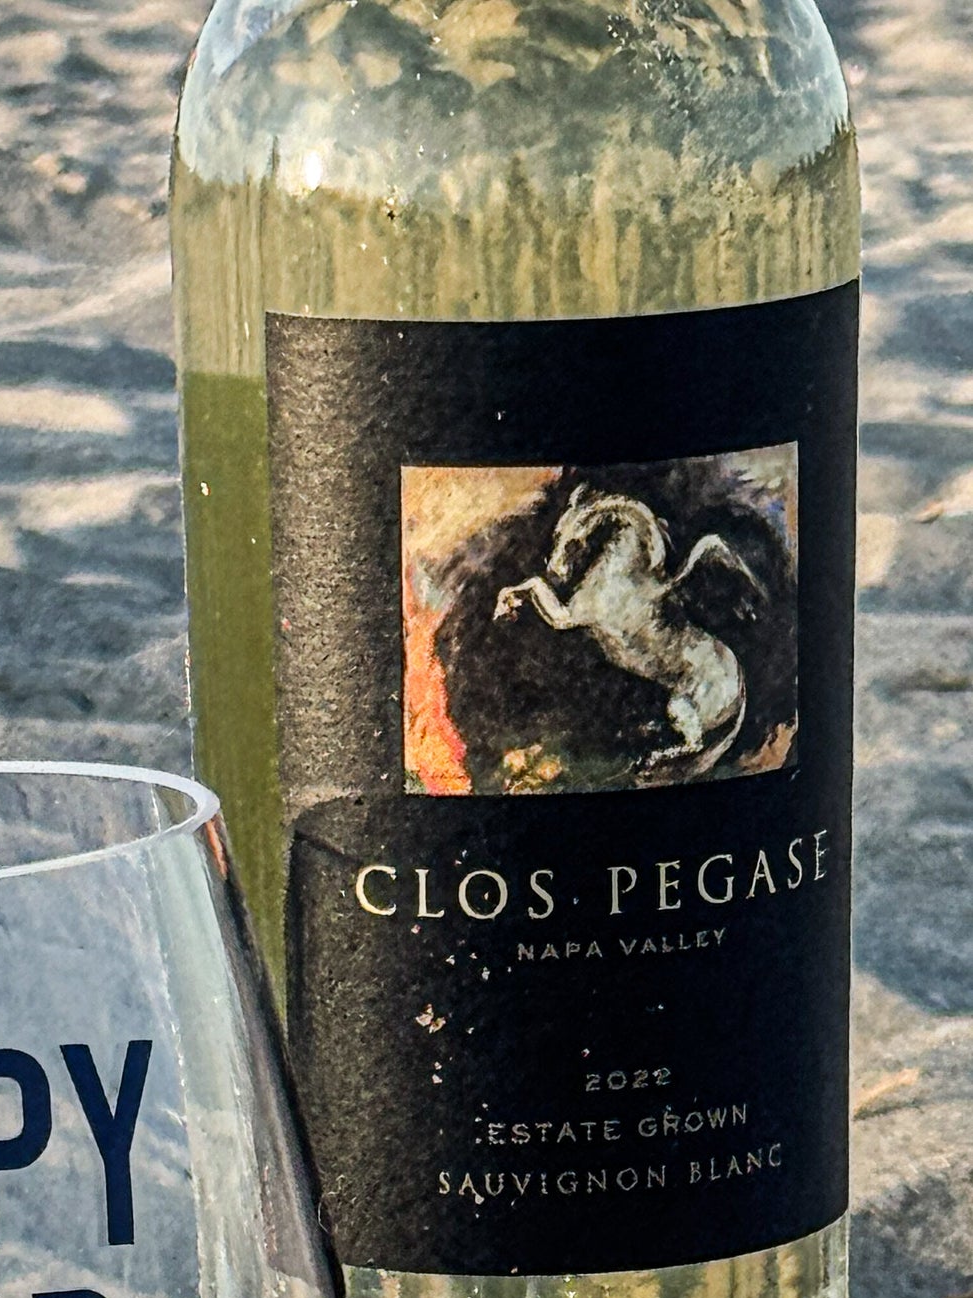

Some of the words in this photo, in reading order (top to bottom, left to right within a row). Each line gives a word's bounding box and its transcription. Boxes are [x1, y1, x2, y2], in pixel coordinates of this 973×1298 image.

[355, 865, 555, 920] CLOS
[607, 829, 829, 916] PEGASE
[517, 940, 603, 961] NAPA
[619, 927, 726, 956] VALLEY
[488, 1120, 620, 1145] ESTATE
[638, 1103, 747, 1137] GROWN
[438, 1165, 666, 1197] SAUVIGNON
[688, 1143, 782, 1184] BLANC
